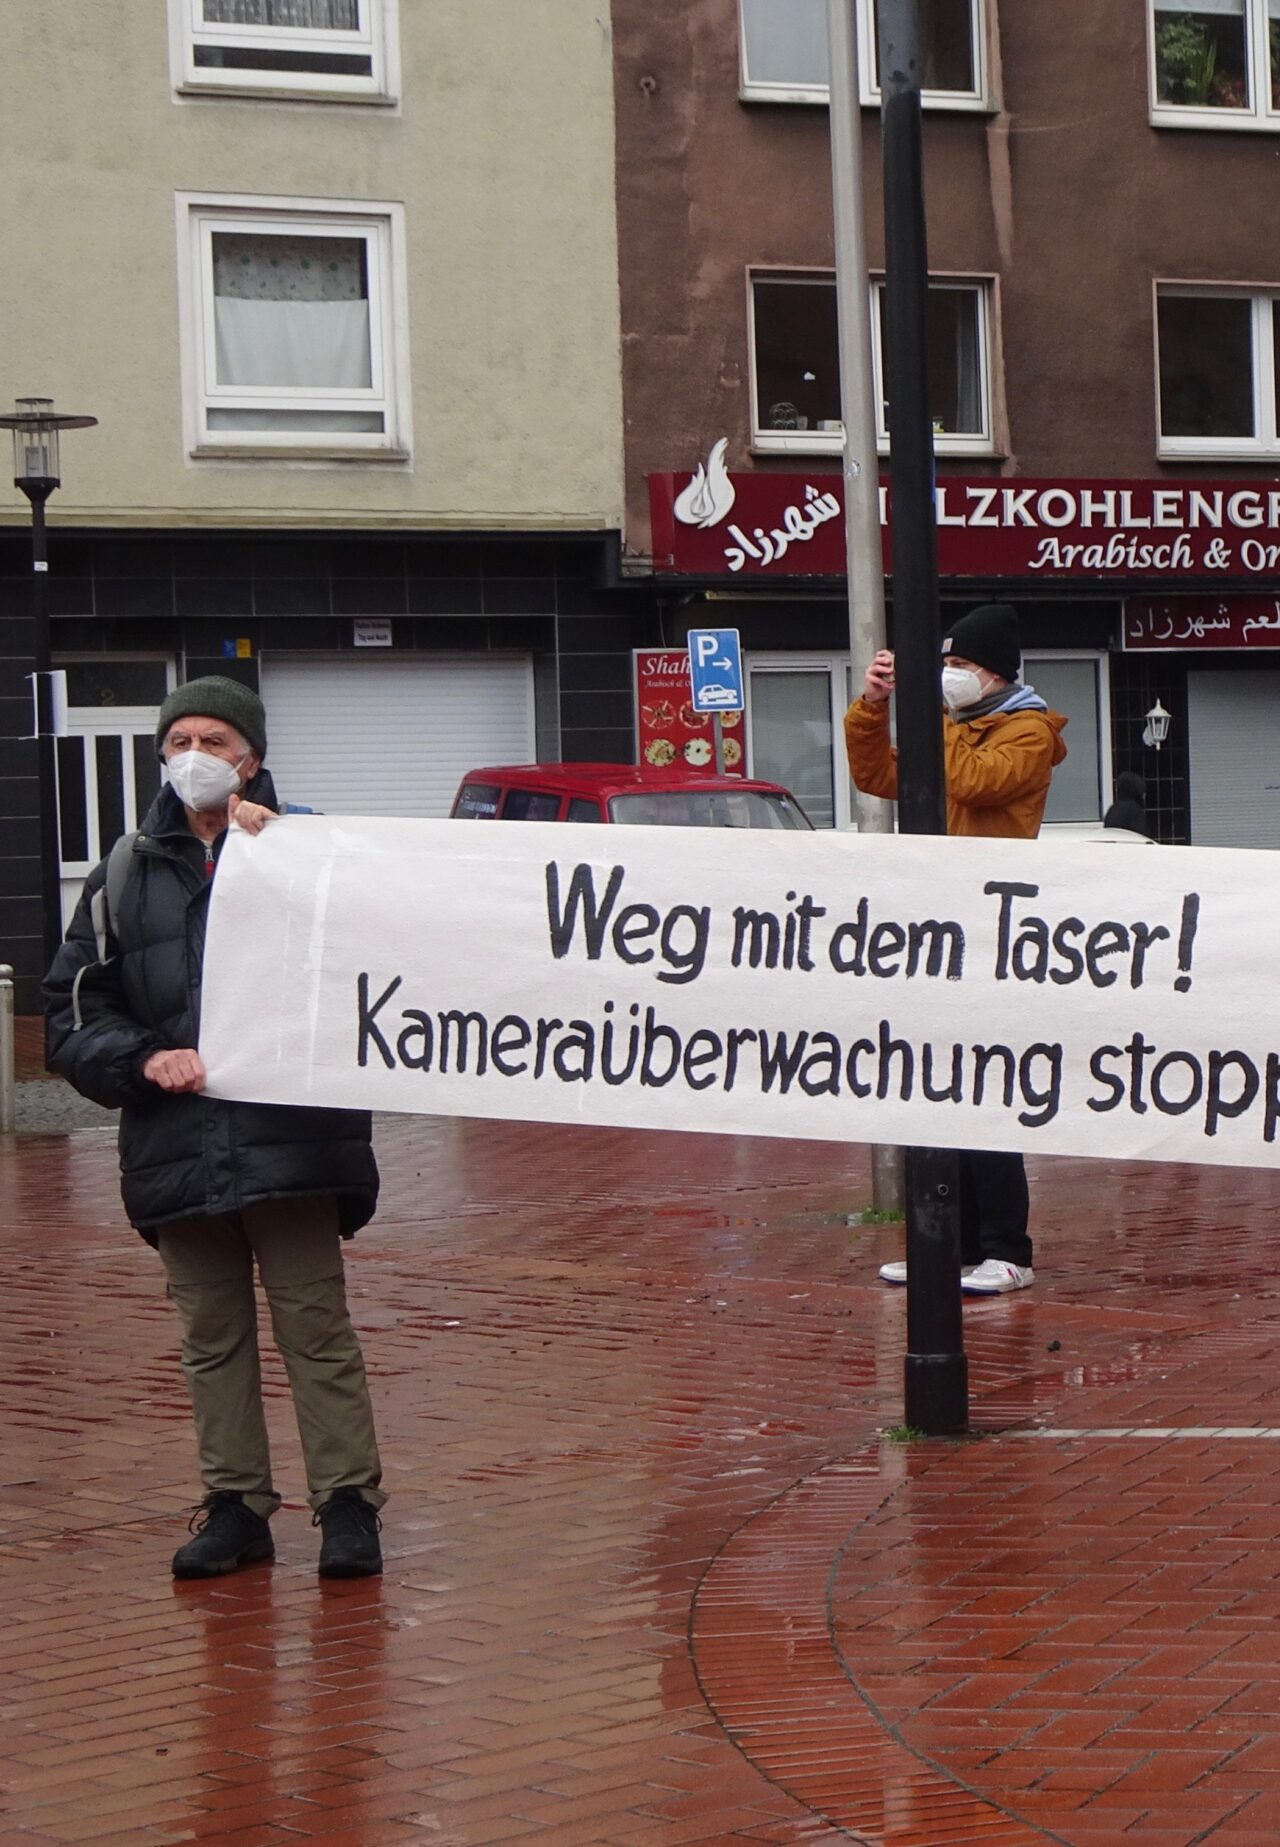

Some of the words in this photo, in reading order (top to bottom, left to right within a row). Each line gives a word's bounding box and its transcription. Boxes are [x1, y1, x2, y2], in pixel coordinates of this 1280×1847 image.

[724, 484, 840, 572] شهرزاد
[1028, 533, 1194, 569] Arabisch
[1203, 537, 1232, 569] &
[1130, 604, 1231, 639] شهرزاد
[642, 655, 691, 676] Shah
[697, 636, 719, 667] P
[545, 860, 711, 984] Weg
[731, 891, 826, 971] mit
[829, 897, 965, 980] dem
[984, 880, 1200, 993] Taser!
[357, 972, 1063, 1127] Kameraüberwachung
